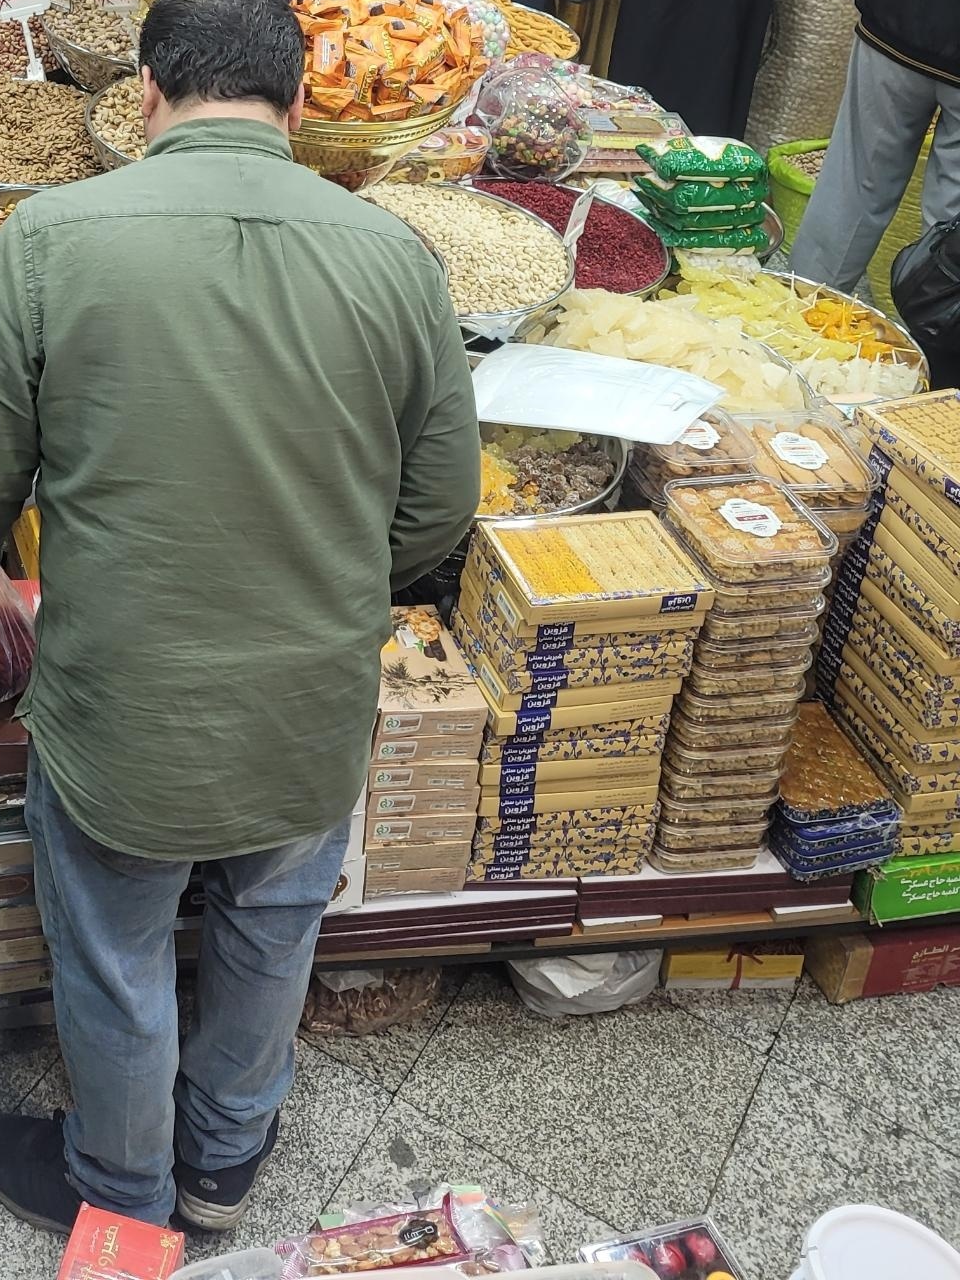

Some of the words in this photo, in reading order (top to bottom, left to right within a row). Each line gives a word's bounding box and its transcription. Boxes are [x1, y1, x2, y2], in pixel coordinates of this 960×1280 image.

[543, 625, 570, 636] قزوین
[531, 660, 557, 670] قزوین
[537, 680, 561, 691] قزوین
[527, 698, 552, 708] قزوین
[521, 722, 545, 733] قزوین
[513, 734, 537, 744] قزوین
[507, 754, 531, 762] قزوین
[506, 773, 530, 783] قزوین
[505, 785, 529, 794] قزوین
[504, 805, 528, 814] قزوین
[506, 823, 531, 831] قزوین
[490, 872, 514, 880] قزوین
[929, 876, 946, 888] حاج
[926, 890, 941, 900] حاج
